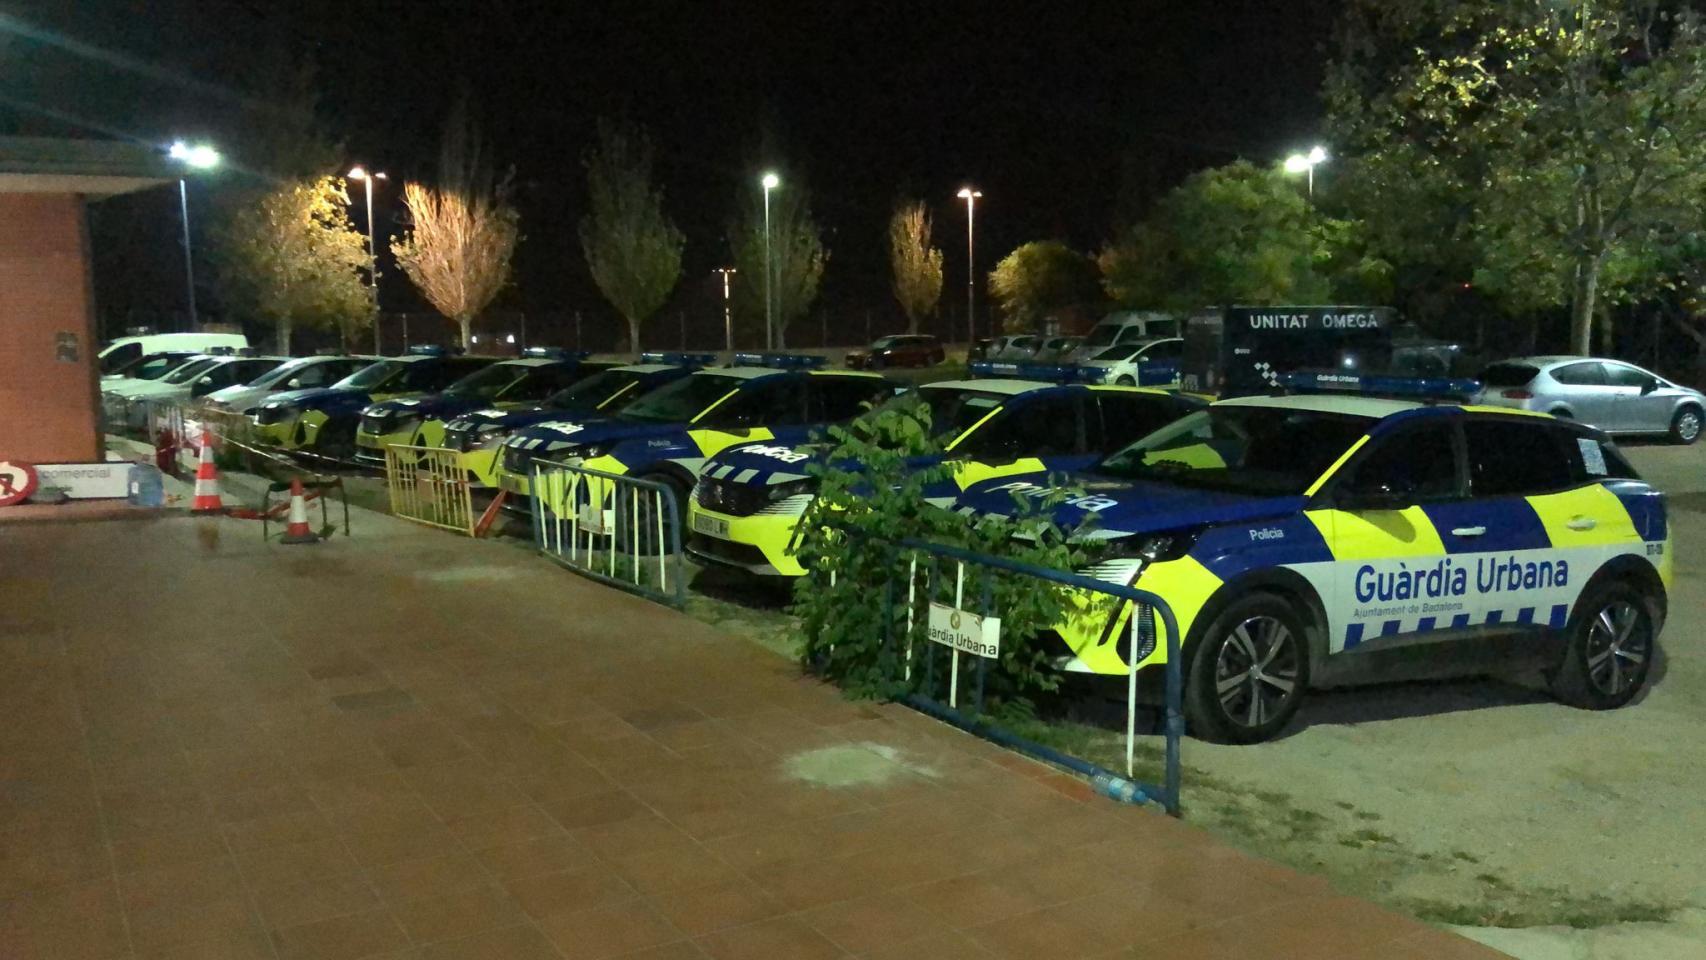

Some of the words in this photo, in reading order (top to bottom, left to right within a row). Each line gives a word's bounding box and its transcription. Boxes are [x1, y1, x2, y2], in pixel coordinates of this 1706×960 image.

[1250, 314, 1309, 328] UNITAT
[1322, 314, 1378, 328] OMEGA
[41, 466, 111, 478] comercial
[1355, 558, 1467, 603] Guàrdia
[1476, 556, 1569, 593] Urbana
[1354, 604, 1405, 618] Ajuntament
[1408, 603, 1419, 614] de
[956, 632, 997, 655] Urbana
